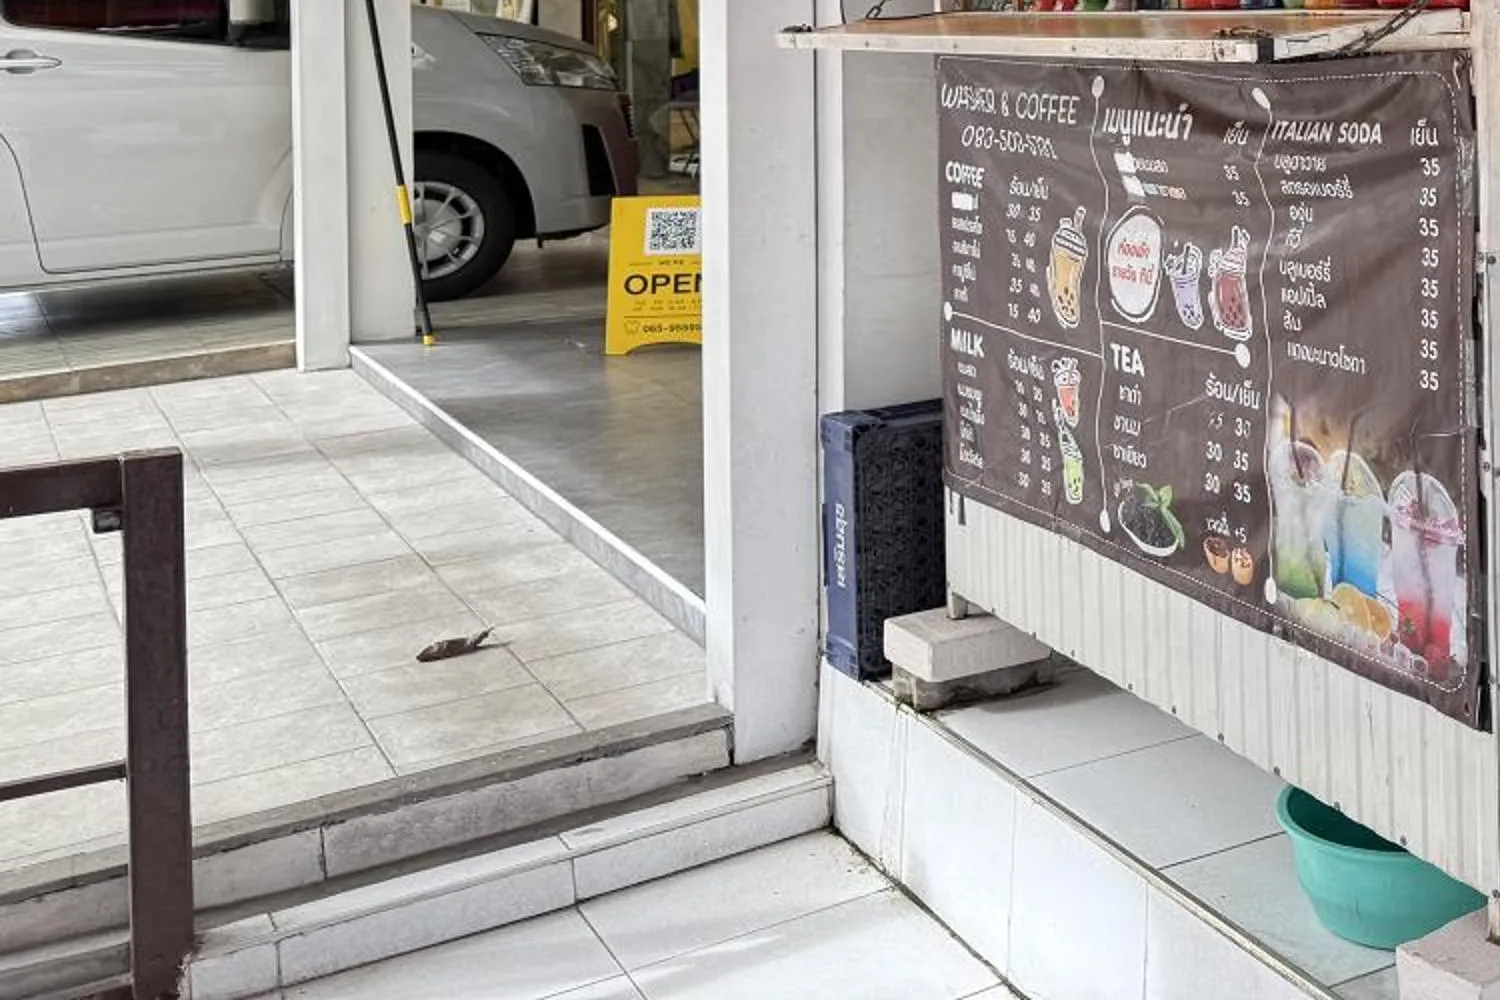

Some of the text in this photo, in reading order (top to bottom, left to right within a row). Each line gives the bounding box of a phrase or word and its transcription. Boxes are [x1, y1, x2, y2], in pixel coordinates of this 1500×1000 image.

[1015, 92, 1081, 124] COFFEE
[1102, 103, 1193, 146] เมนูแนะนำ
[1271, 120, 1383, 145] ITALIAN SODA
[1410, 117, 1439, 146] เย็น
[1420, 158, 1440, 177] 35
[1419, 187, 1438, 207] 35
[1419, 217, 1439, 237] 35
[1421, 247, 1439, 268] 35
[1421, 277, 1439, 299] 35
[1421, 308, 1439, 329] 35
[951, 327, 985, 358] MILK
[1420, 338, 1438, 361] 35
[1110, 343, 1145, 377] TEA
[1420, 368, 1439, 391] 35
[1205, 441, 1249, 471] 30 35
[1205, 472, 1250, 503] 30 35
